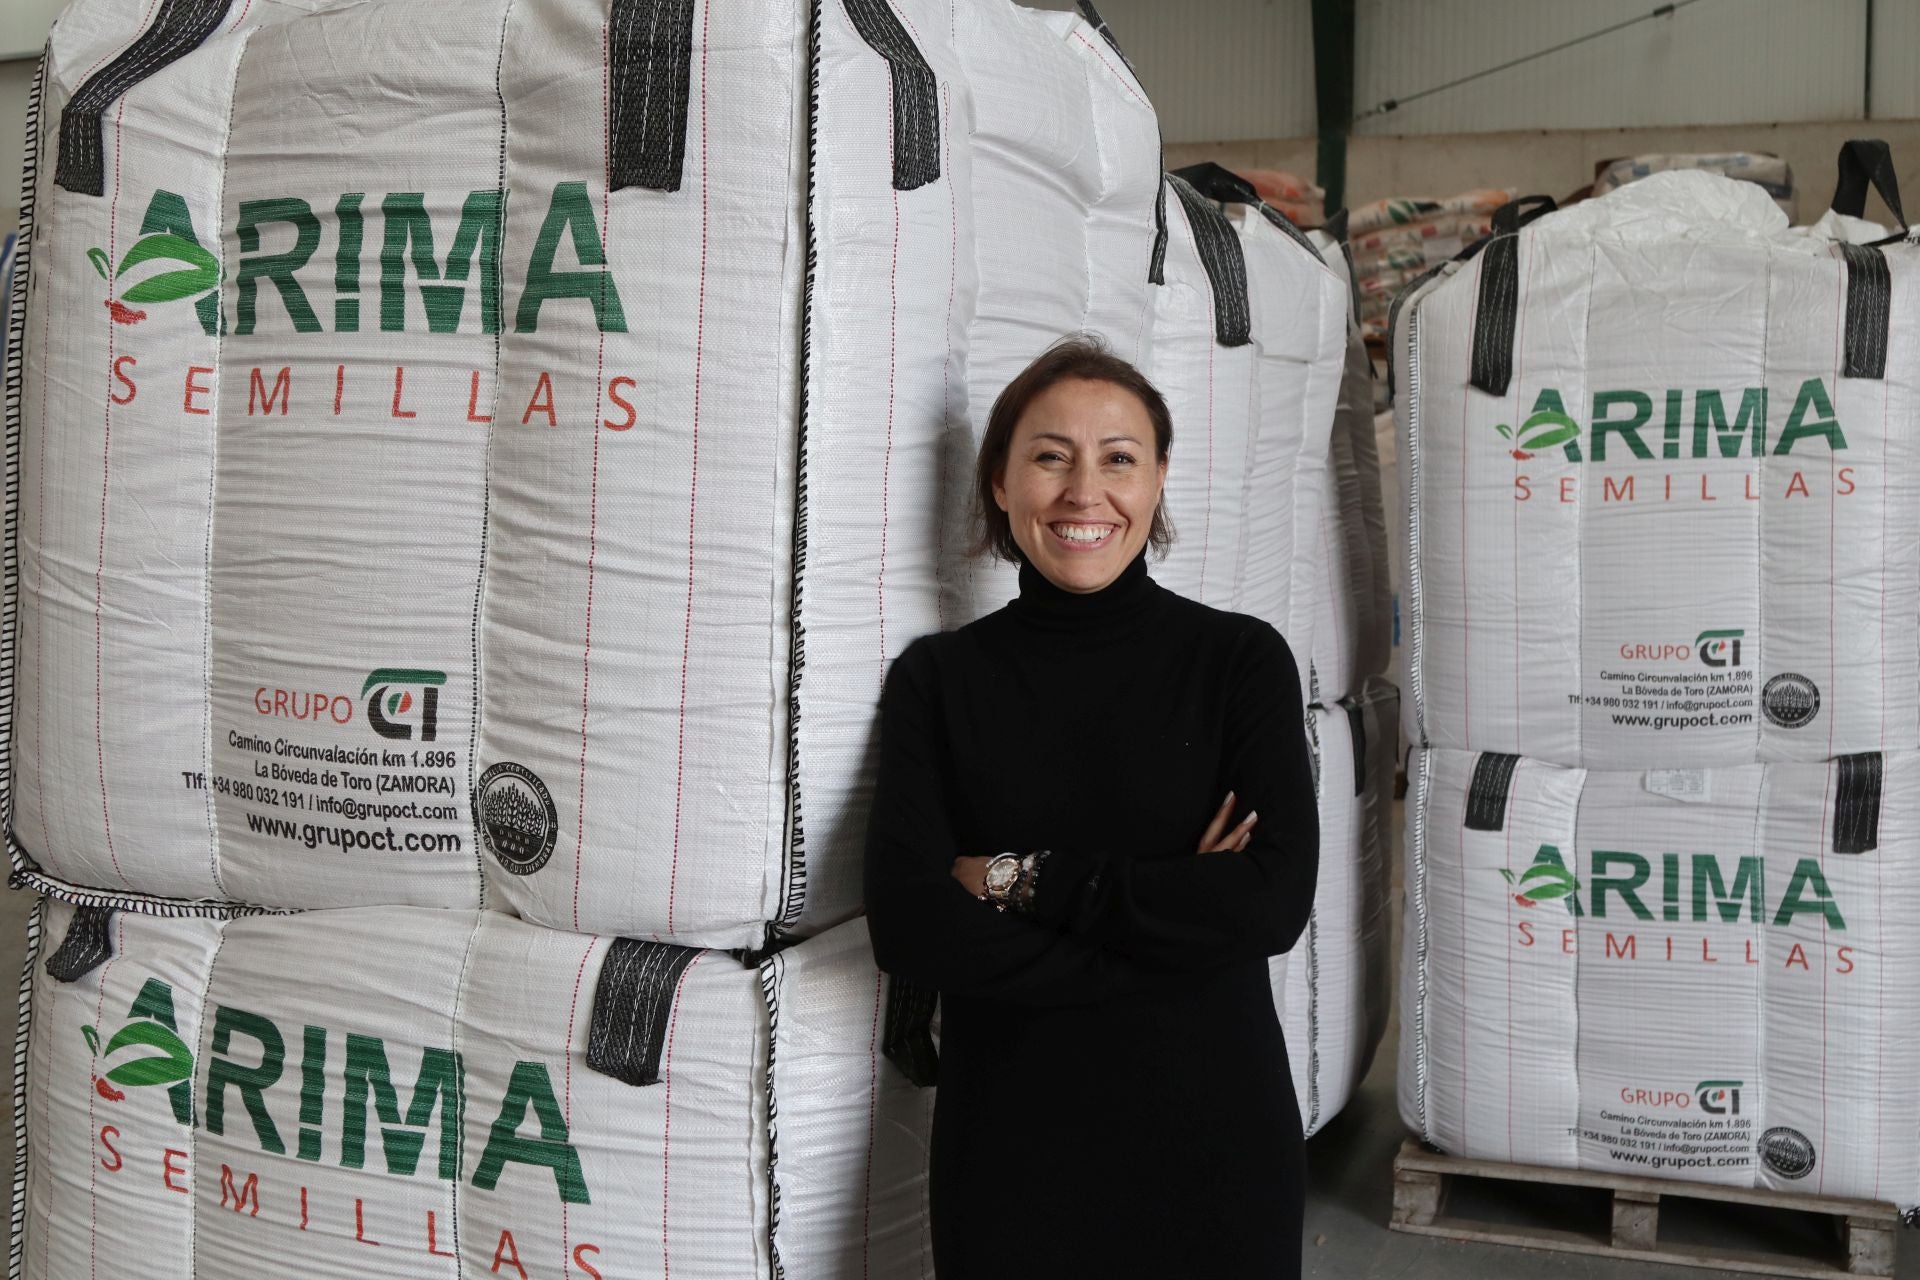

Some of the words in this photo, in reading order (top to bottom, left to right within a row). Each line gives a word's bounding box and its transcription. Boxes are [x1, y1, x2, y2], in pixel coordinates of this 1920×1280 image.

[104, 181, 629, 337] ARIMA
[110, 355, 638, 432] SEMILLAS
[1516, 377, 1849, 463] ARIMA
[1514, 468, 1856, 503] SEMILLAS
[1620, 643, 1690, 660] GRUPO
[1600, 670, 1635, 681] Camino
[1637, 672, 1708, 683] Circunvalación
[1710, 672, 1724, 682] km
[1727, 670, 1753, 682] 1.896
[1622, 685, 1633, 695] La
[1635, 685, 1669, 696] Bóveda
[1670, 687, 1682, 696] de
[1684, 686, 1704, 696] Toro
[1706, 684, 1753, 698] (ZAMORA)
[255, 687, 352, 725] GRUPO
[1585, 696, 1601, 706] +34
[1603, 697, 1621, 707] 980
[1622, 698, 1640, 709] 032
[1643, 699, 1658, 709] 191
[1666, 698, 1753, 712] info@grupoct.com
[1612, 712, 1753, 730] www.grupoct.com
[229, 730, 272, 753] Camino
[274, 738, 378, 766] Circunvalación
[382, 749, 406, 767] km
[410, 750, 457, 768] 1.896
[255, 760, 269, 778] La
[272, 763, 318, 785] Bóveda
[321, 770, 338, 787] de
[340, 771, 372, 790] Toro
[376, 774, 456, 798] (ZAMORA)
[212, 776, 230, 795] +34
[233, 782, 253, 800] 980
[256, 786, 279, 806] 032
[281, 791, 304, 810] 191
[316, 795, 458, 822] info@grupoct.com
[247, 812, 461, 853] www.grupoct.com
[1516, 843, 1847, 930] ARIMA
[1518, 921, 1855, 974] SEMILLAS
[103, 977, 592, 1205] ARIMA
[1621, 1087, 1690, 1108] GRUPO
[1600, 1110, 1635, 1124] Camino
[1637, 1115, 1707, 1129] Circunvalación
[1709, 1119, 1723, 1128] km
[1726, 1119, 1751, 1129] 1.896
[1621, 1126, 1632, 1135] La
[1634, 1127, 1667, 1139] Bóveda
[1668, 1131, 1680, 1140] de
[1682, 1131, 1702, 1141] Toro
[1704, 1131, 1751, 1143] (ZAMORA)
[1584, 1130, 1599, 1141] +34
[1601, 1134, 1618, 1145] 980
[1620, 1138, 1638, 1148] 032
[1640, 1141, 1656, 1150] 191
[1663, 1143, 1750, 1155] info@grupoct.com
[1610, 1149, 1750, 1170] www.grupoct.com
[101, 1126, 601, 1280] SEMILLAS
